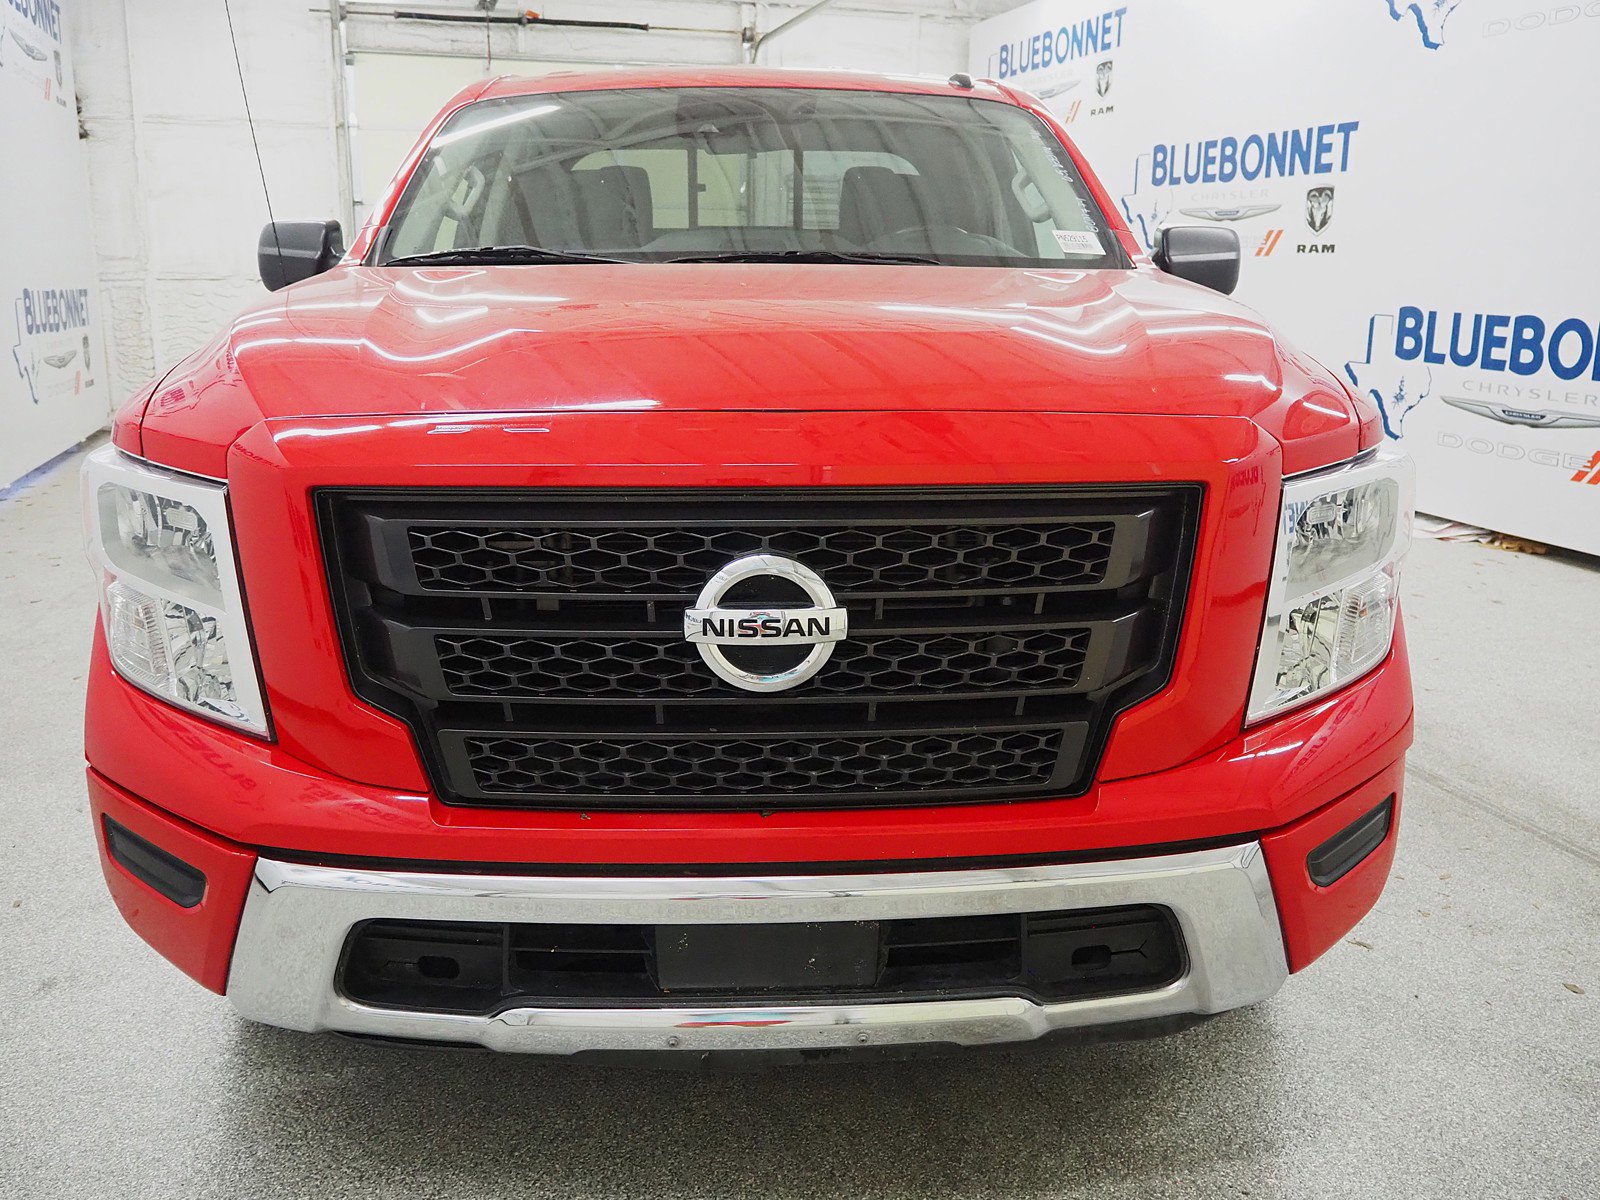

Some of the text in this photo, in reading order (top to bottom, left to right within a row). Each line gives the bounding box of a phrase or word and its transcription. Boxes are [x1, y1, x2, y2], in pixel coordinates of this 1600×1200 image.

[999, 7, 1127, 79] BLUEBONNET
[1090, 106, 1114, 116] RAM
[1151, 121, 1359, 186] BLUEBONNET
[1297, 244, 1335, 253] RAM
[23, 288, 89, 335] BLUEBONNET
[1395, 306, 1600, 382] BLUEBO
[1462, 379, 1598, 406] CHRYSLER
[1437, 431, 1593, 472] DODGE
[702, 617, 830, 638] NISSAN
